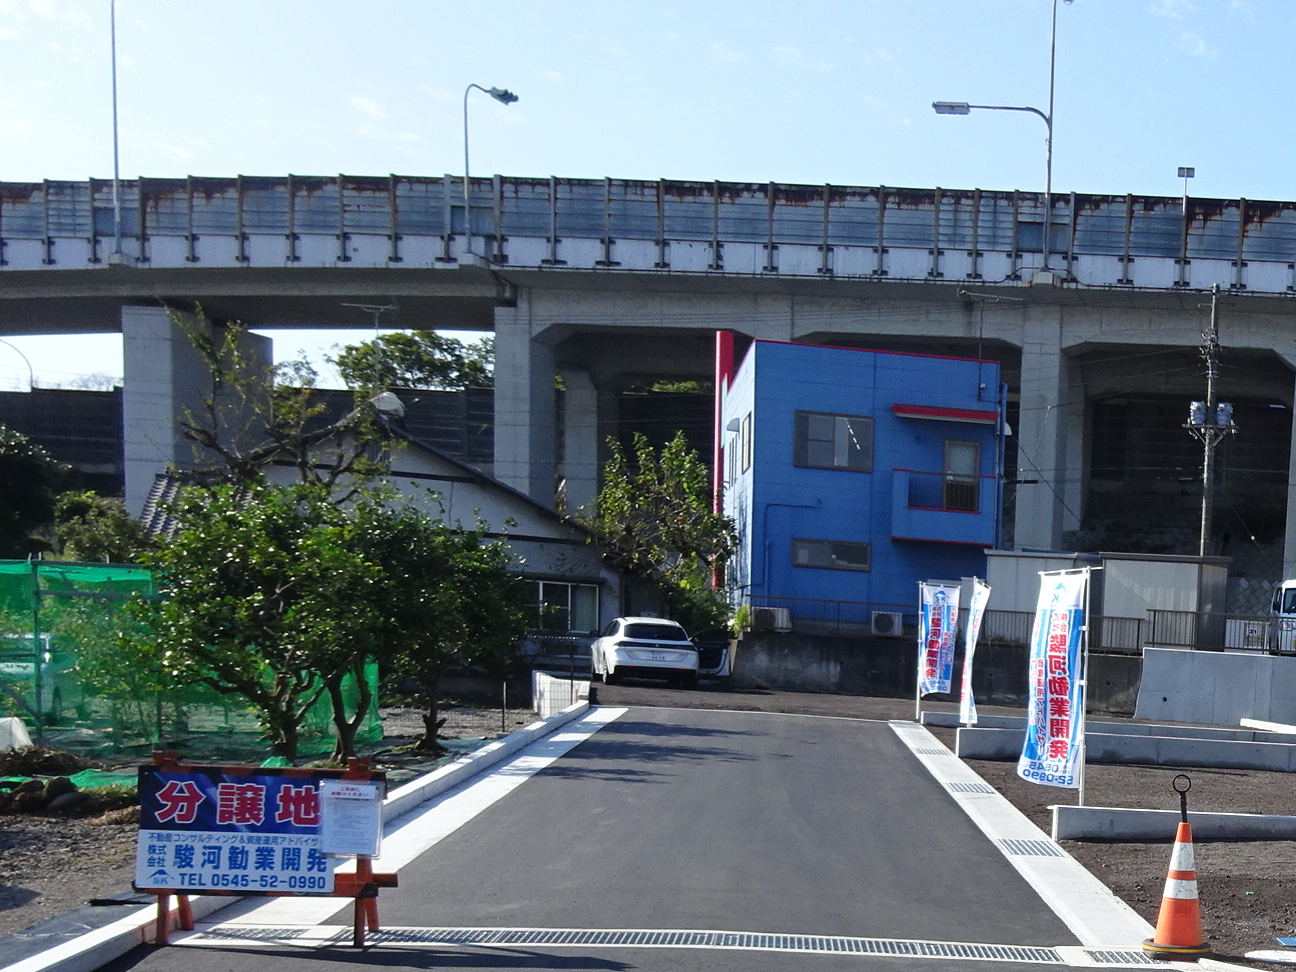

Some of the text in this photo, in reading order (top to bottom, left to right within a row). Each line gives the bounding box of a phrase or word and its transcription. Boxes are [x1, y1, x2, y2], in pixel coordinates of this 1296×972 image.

[155, 780, 320, 827] 分譲地
[148, 832, 321, 847] 不動産コンサルティング&資産運用アドバイザ
[173, 844, 328, 873] 駿河勧業開発
[152, 877, 169, 885] SK
[179, 873, 326, 889] TEL 0545-52-0990
